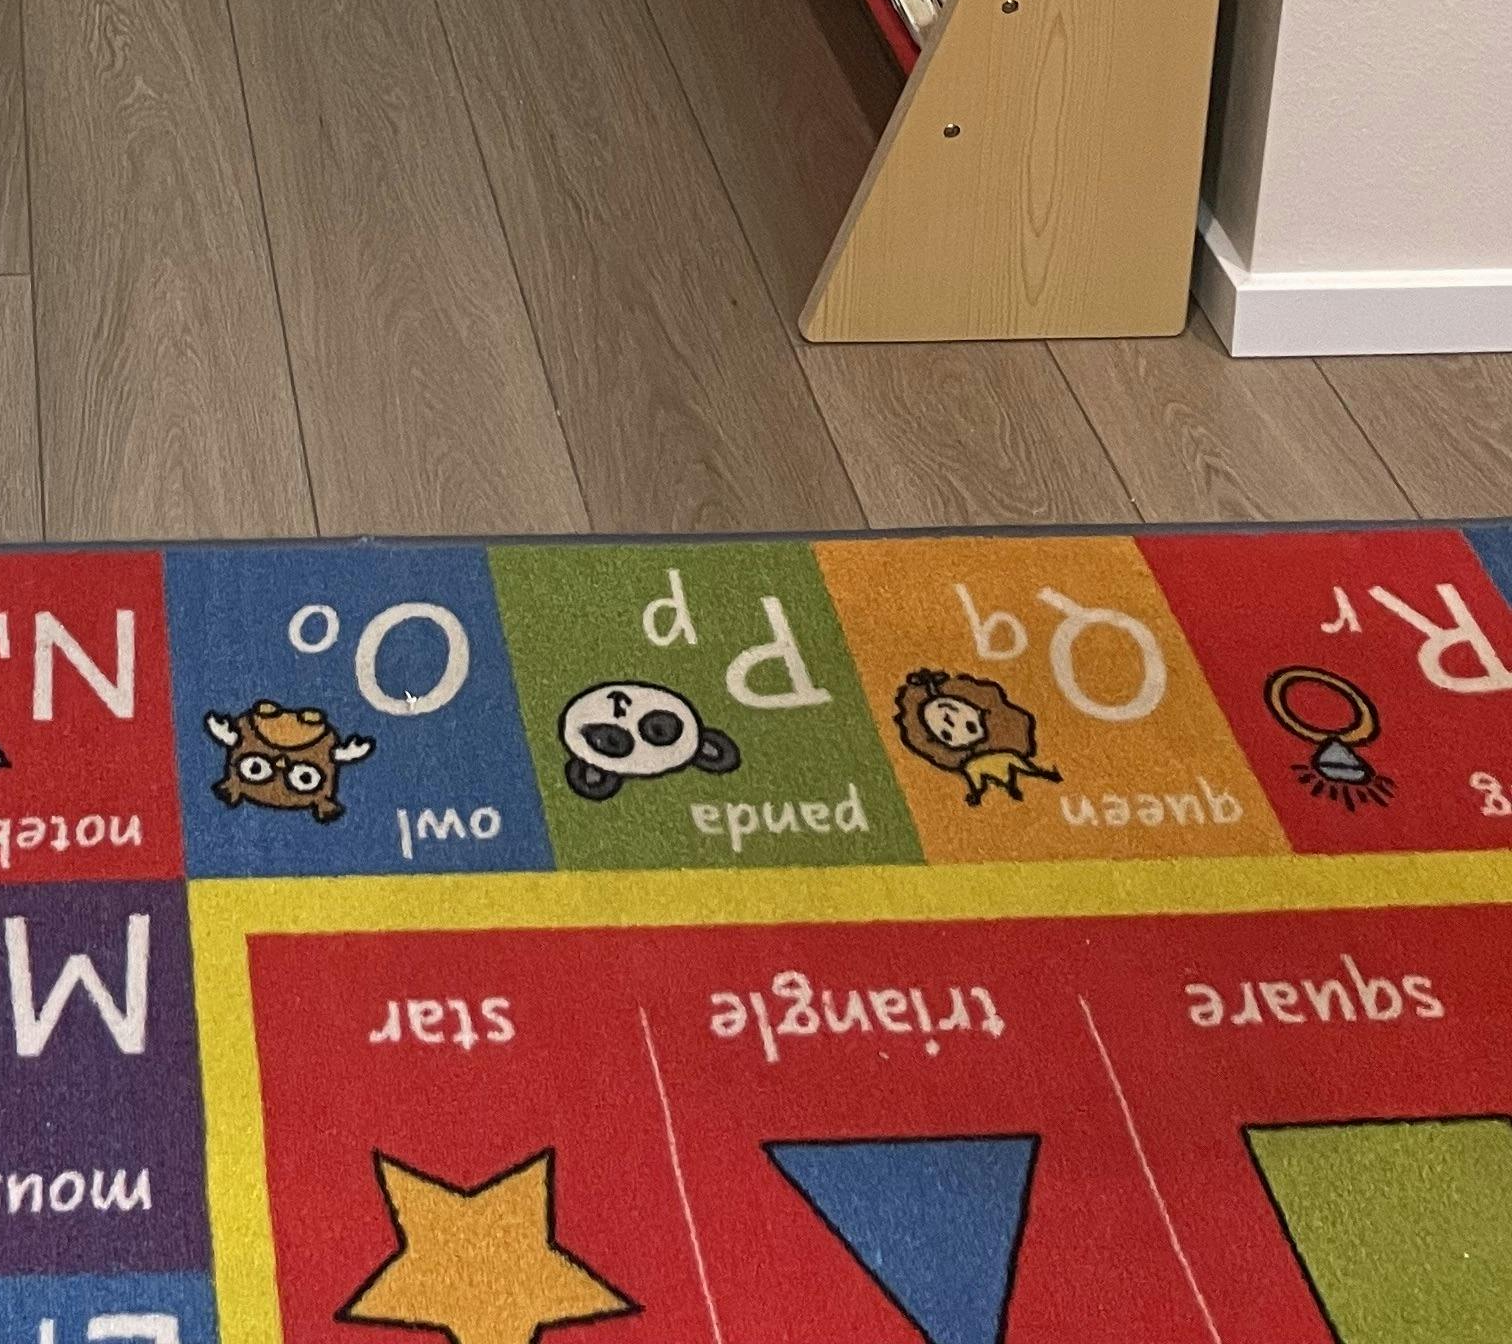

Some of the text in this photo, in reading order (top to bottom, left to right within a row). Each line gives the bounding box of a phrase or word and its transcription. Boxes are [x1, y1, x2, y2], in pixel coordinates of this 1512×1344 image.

[399, 806, 502, 860] owl
[692, 784, 867, 851] panda
[1062, 790, 1244, 847] queen
[709, 972, 1007, 1064] triangle
[1186, 953, 1446, 1026] square
[369, 997, 515, 1045] star
